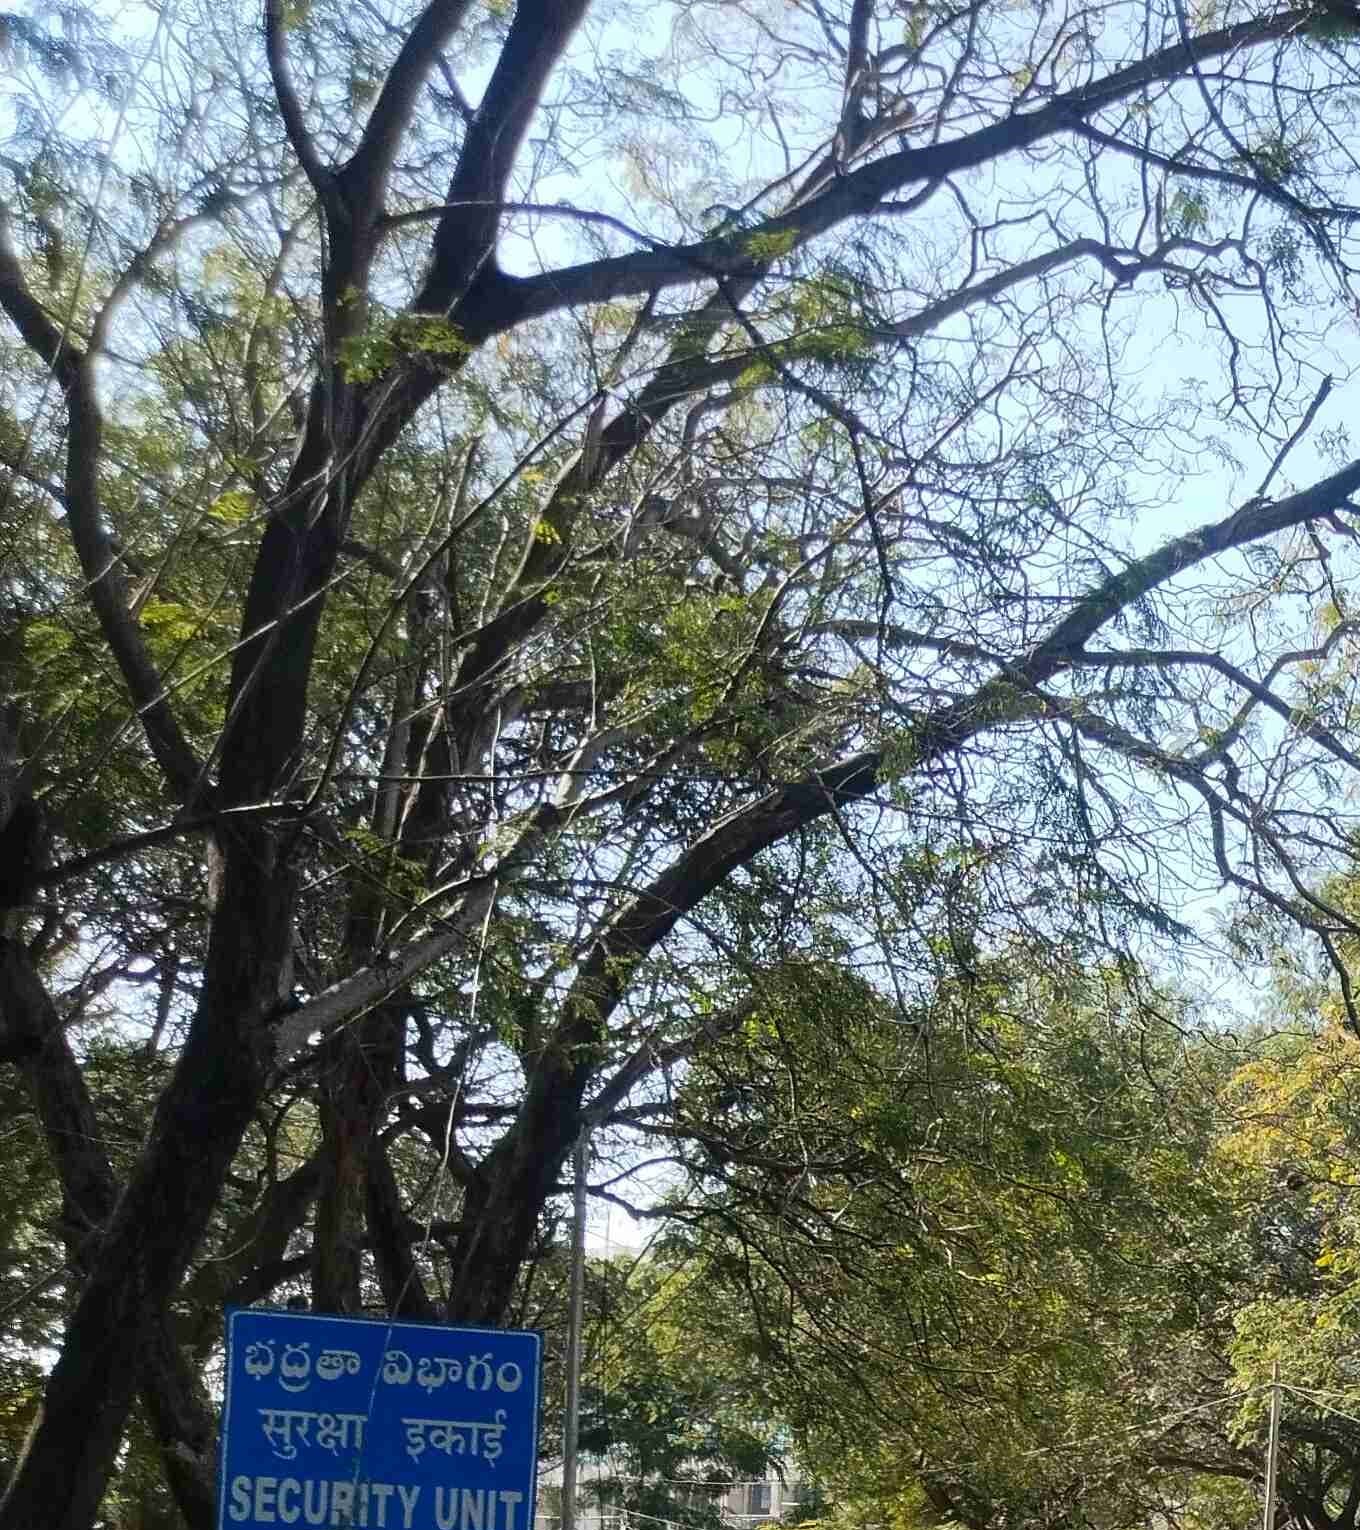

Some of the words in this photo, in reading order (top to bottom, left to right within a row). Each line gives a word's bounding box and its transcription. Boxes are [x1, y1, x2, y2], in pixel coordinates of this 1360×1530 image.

[245, 1339, 361, 1392] భద్రతా
[383, 1351, 523, 1393] విభాగం
[257, 1408, 368, 1460] सुरक्षा
[402, 1409, 506, 1467] इकाई
[229, 1475, 420, 1529] SECURITY
